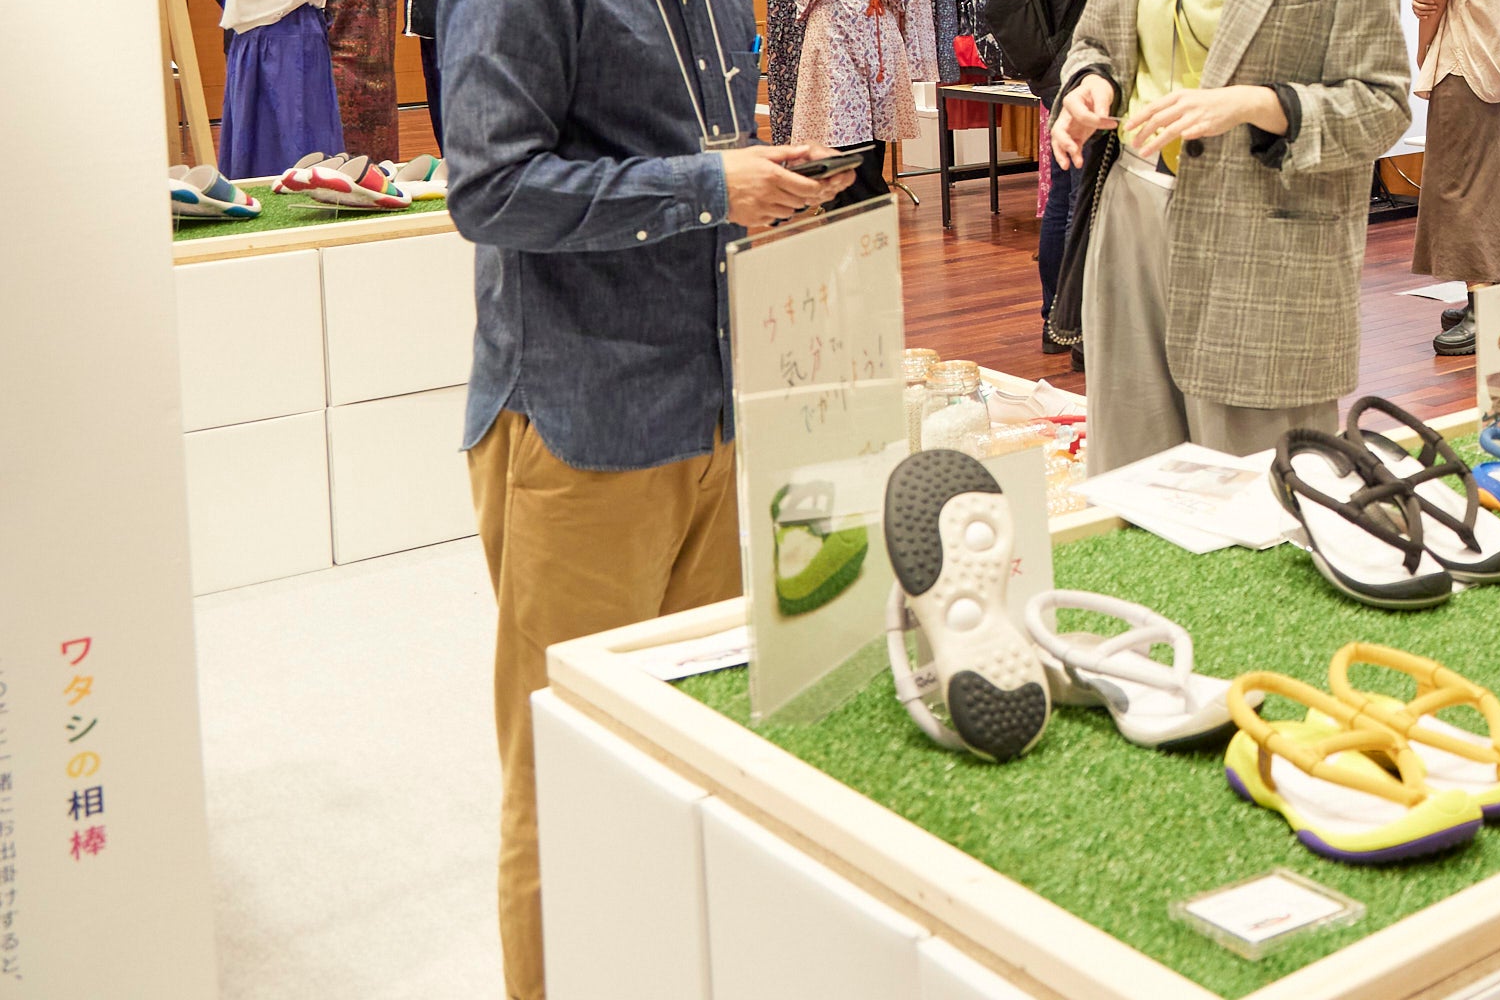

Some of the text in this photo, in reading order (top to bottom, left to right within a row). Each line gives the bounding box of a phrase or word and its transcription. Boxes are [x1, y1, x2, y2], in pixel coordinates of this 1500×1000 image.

[61, 637, 106, 860] ワタシの相棒
